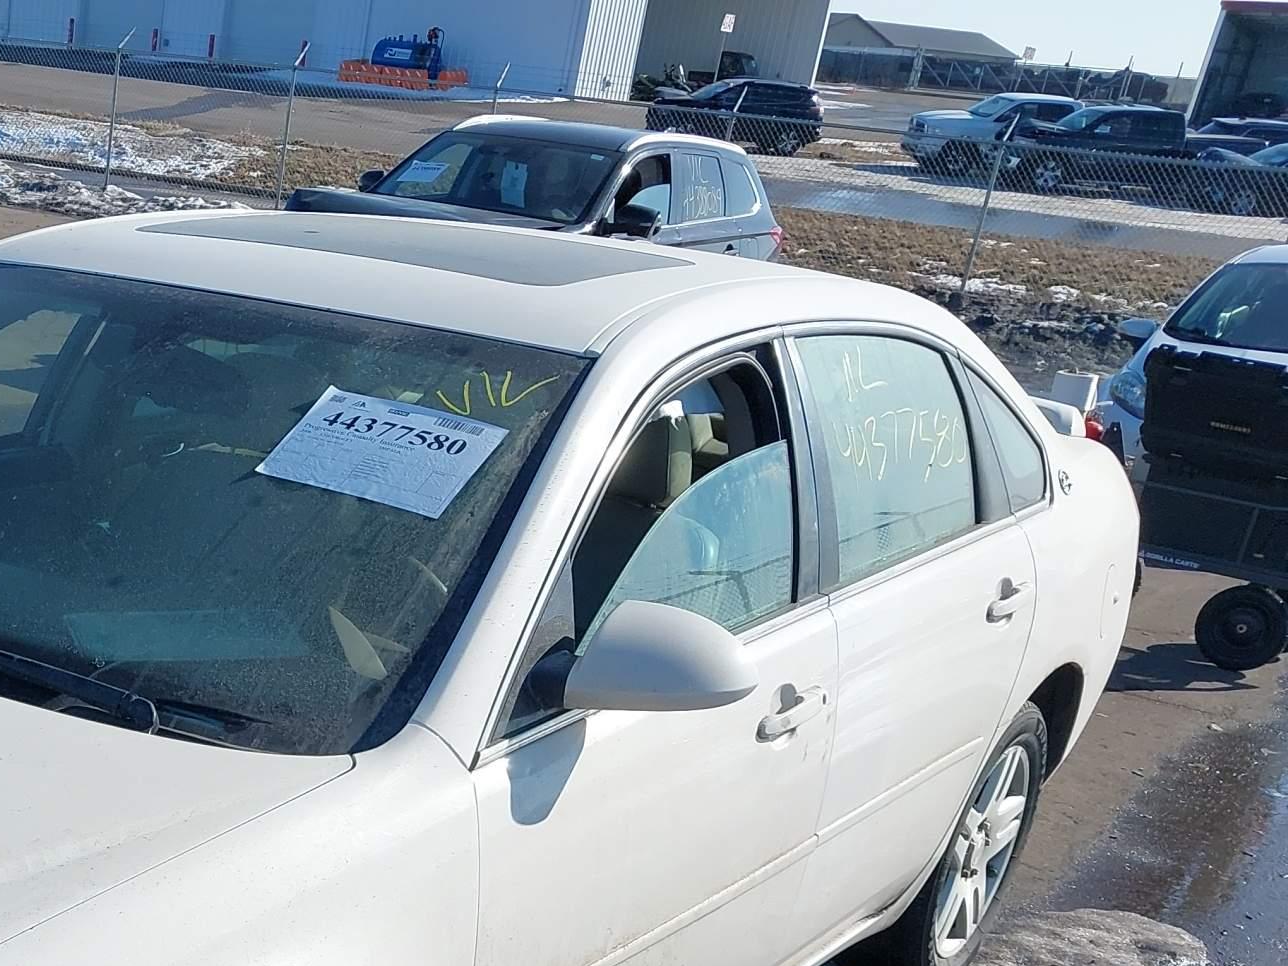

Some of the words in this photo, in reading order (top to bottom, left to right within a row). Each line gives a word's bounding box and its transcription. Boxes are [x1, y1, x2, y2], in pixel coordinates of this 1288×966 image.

[436, 370, 561, 415] VIL
[322, 411, 467, 456] 44377580
[346, 430, 377, 443] Casualty
[379, 438, 416, 452] Insurance
